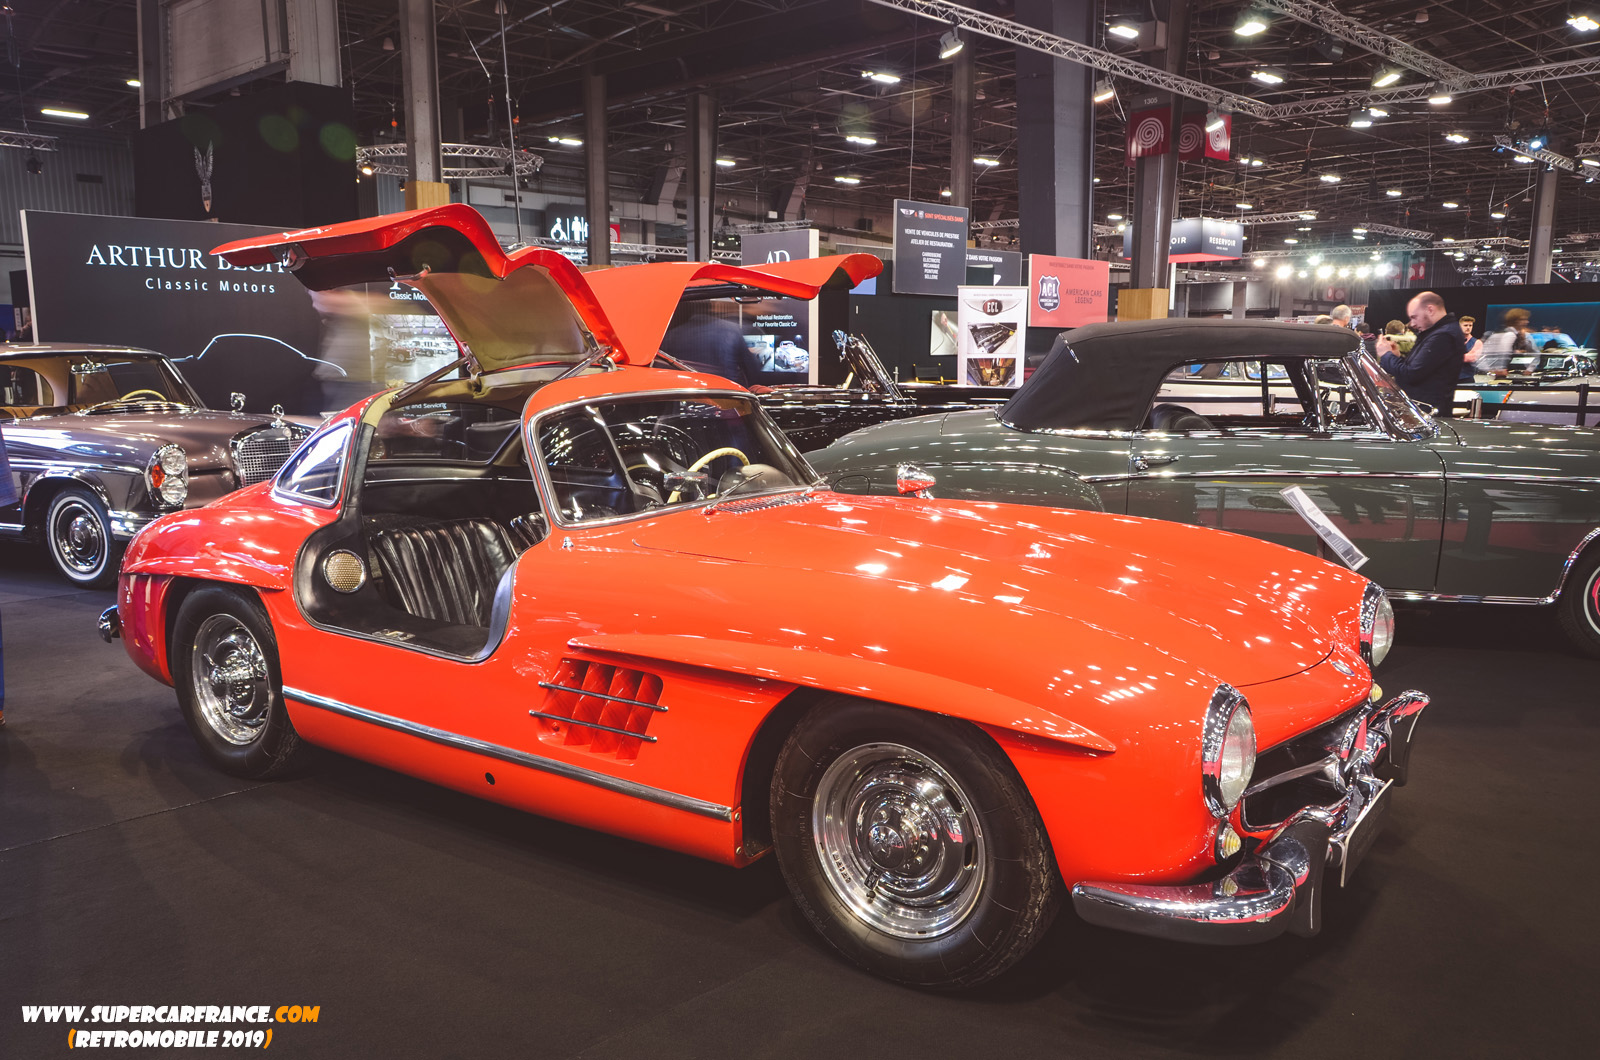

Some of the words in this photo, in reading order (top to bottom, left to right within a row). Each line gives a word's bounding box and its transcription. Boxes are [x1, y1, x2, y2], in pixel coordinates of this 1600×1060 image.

[1171, 236, 1187, 244] OIR
[1209, 237, 1236, 246] RESERVOIR
[86, 244, 207, 270] ARTHUR
[145, 277, 208, 291] Classic
[219, 280, 276, 293] Motors
[1041, 282, 1057, 297] ACL
[389, 291, 412, 301] Classic
[1066, 289, 1089, 297] AMERICAN
[987, 302, 998, 313] ECL
[423, 402, 447, 410] Servicing
